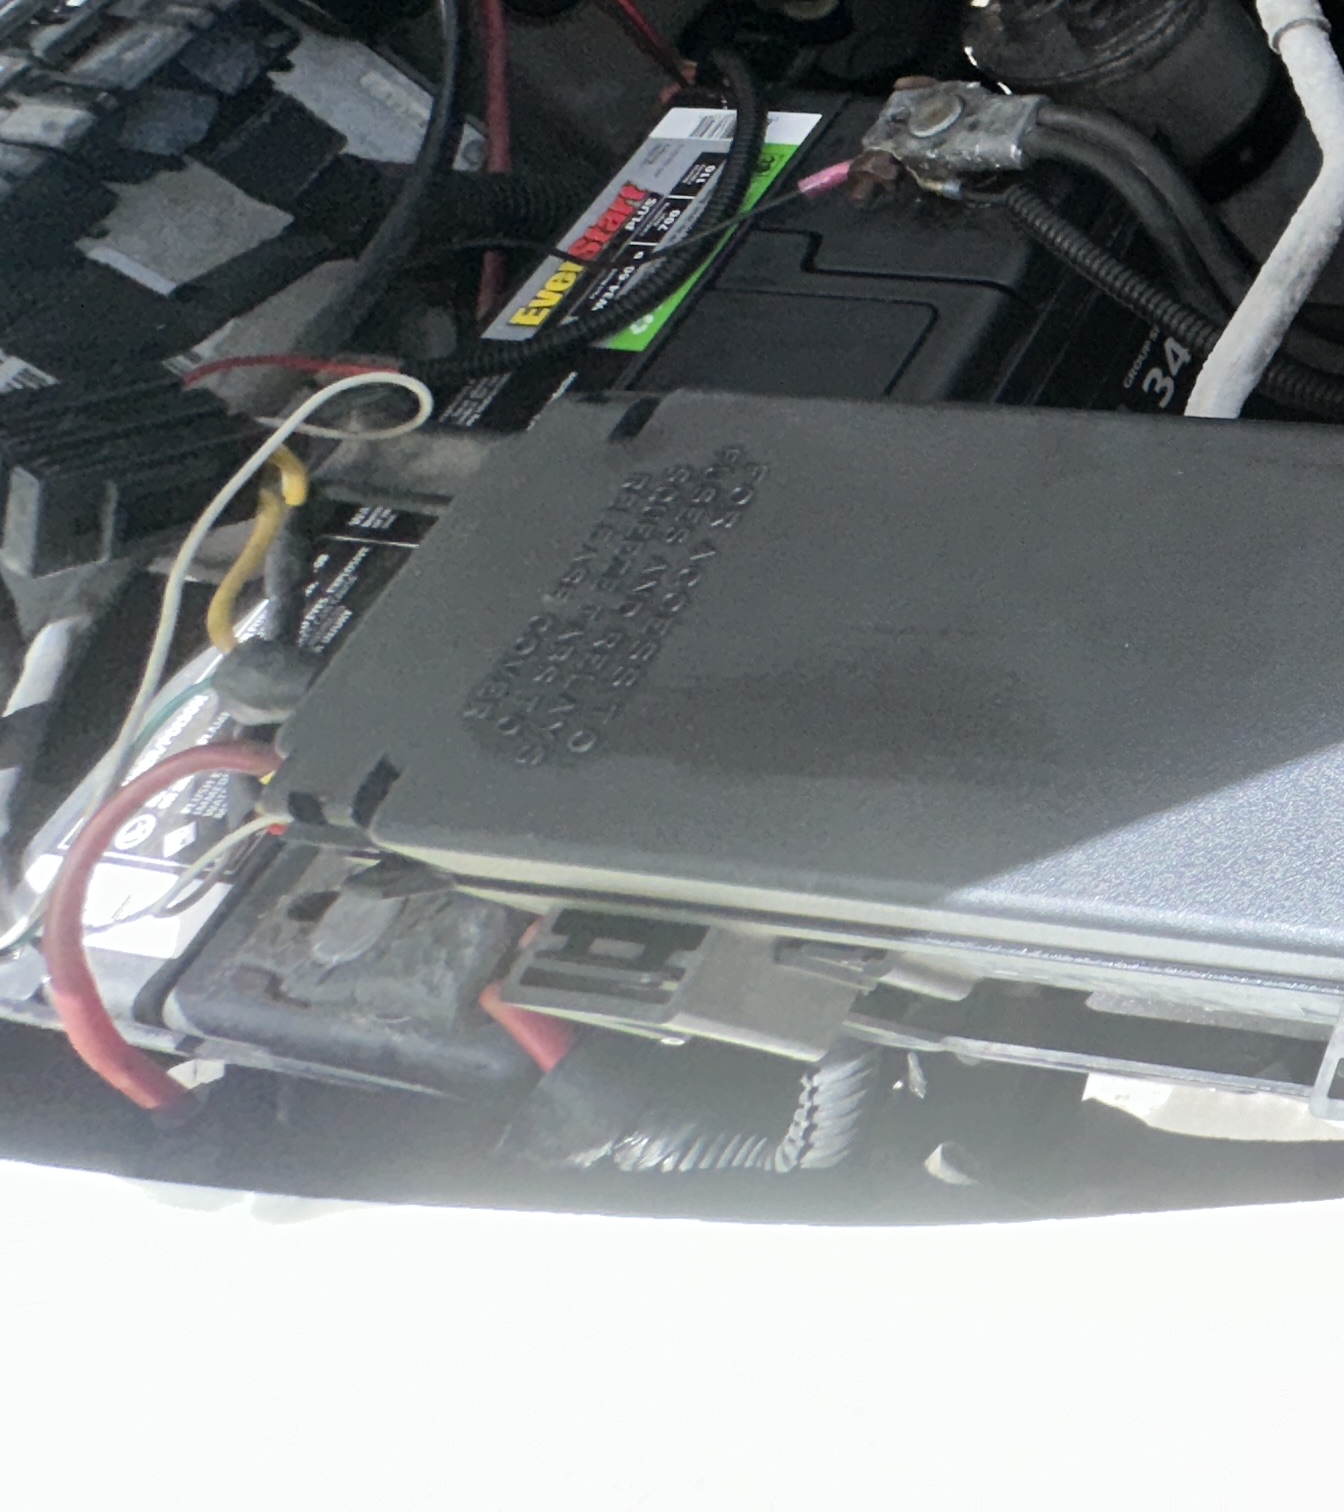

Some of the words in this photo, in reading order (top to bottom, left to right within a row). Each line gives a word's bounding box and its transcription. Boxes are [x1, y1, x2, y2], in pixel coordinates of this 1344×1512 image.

[696, 164, 716, 185] 110
[624, 198, 657, 231] PLUS
[658, 209, 681, 233] 700
[1142, 336, 1192, 409] 34
